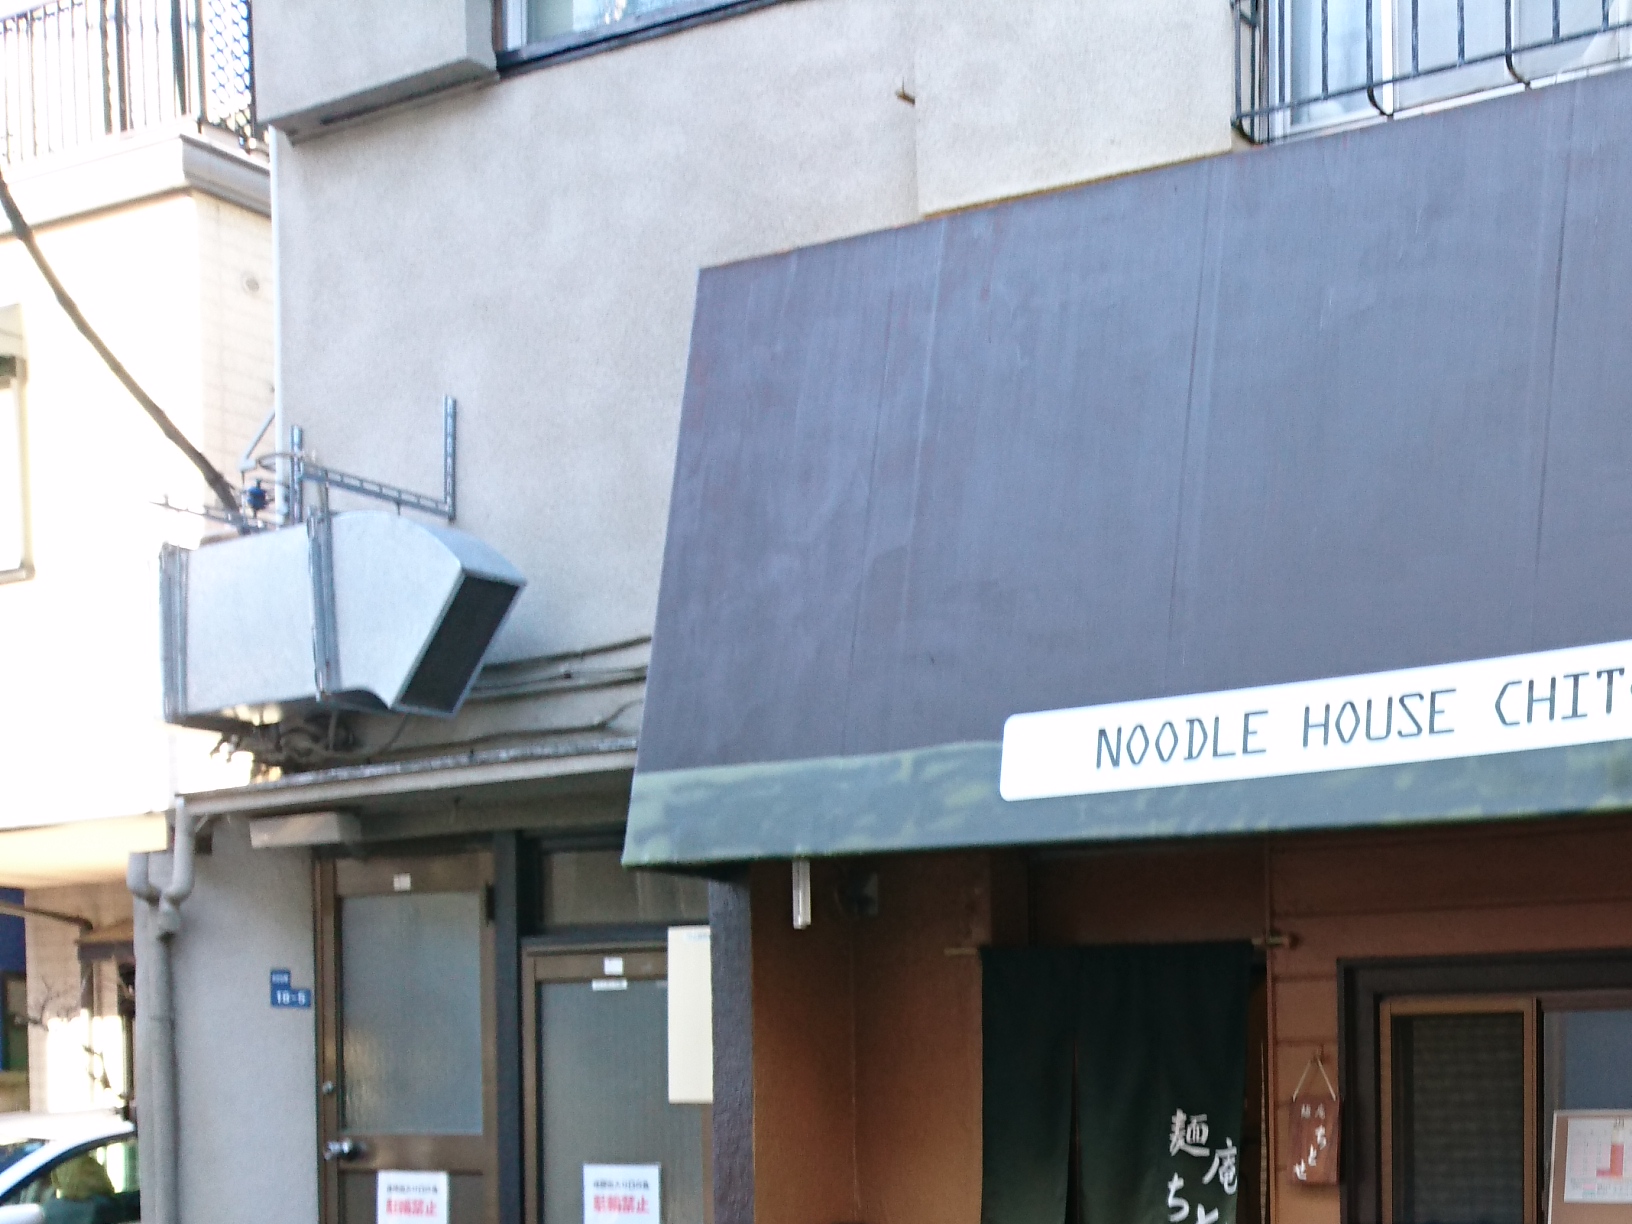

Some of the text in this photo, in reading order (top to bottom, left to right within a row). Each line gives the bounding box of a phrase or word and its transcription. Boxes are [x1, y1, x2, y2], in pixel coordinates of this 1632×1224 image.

[1096, 710, 1269, 769] NOODLE
[1302, 688, 1457, 748] HOUSE
[1169, 1107, 1238, 1196] 麺庵
